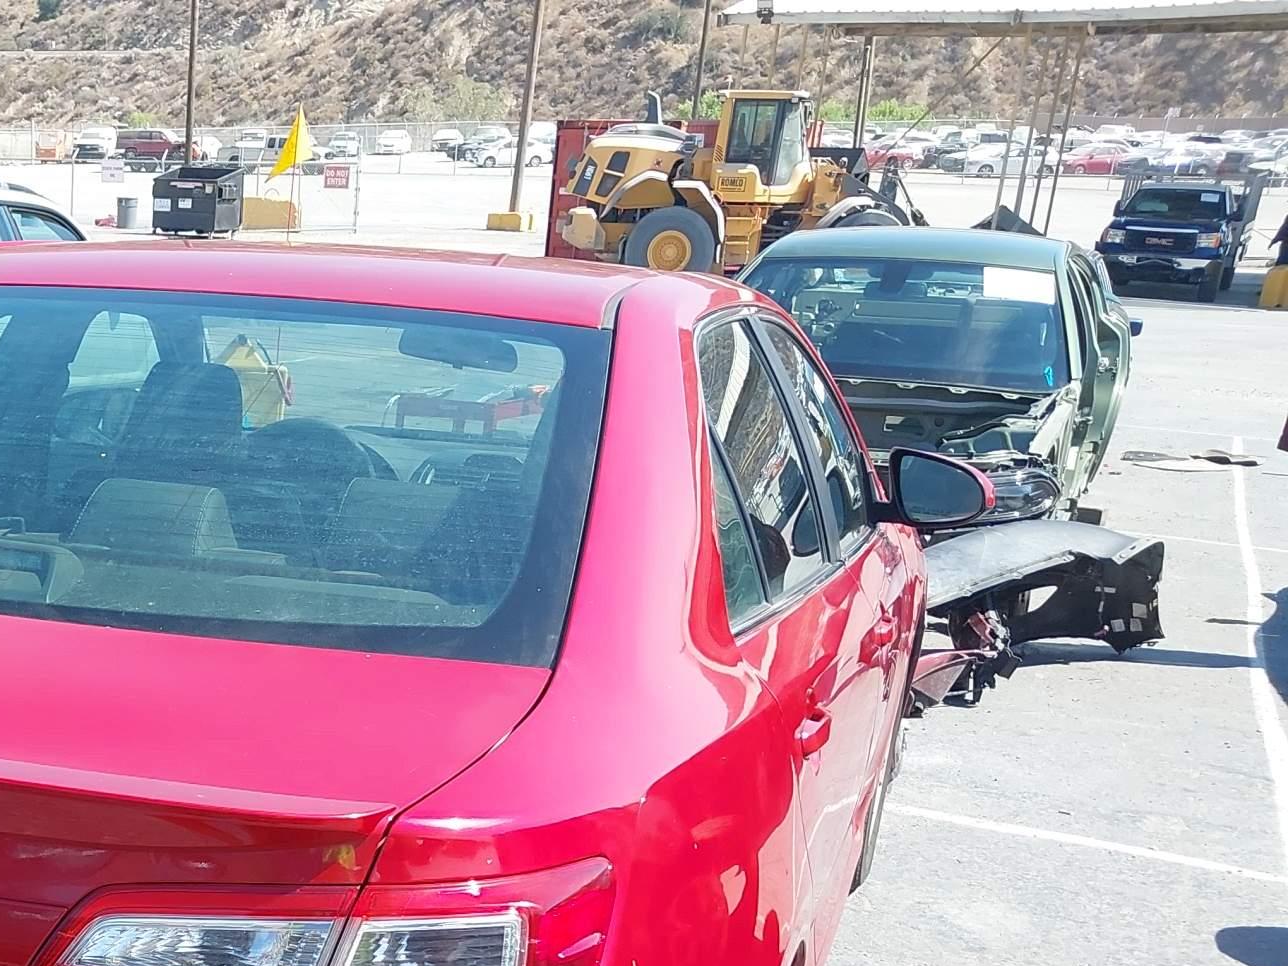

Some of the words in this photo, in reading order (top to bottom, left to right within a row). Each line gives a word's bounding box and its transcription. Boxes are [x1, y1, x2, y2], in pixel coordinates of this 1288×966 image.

[326, 169, 335, 177] DO
[336, 169, 348, 177] NOT
[327, 177, 346, 185] ENTER
[1144, 237, 1174, 246] GMC
